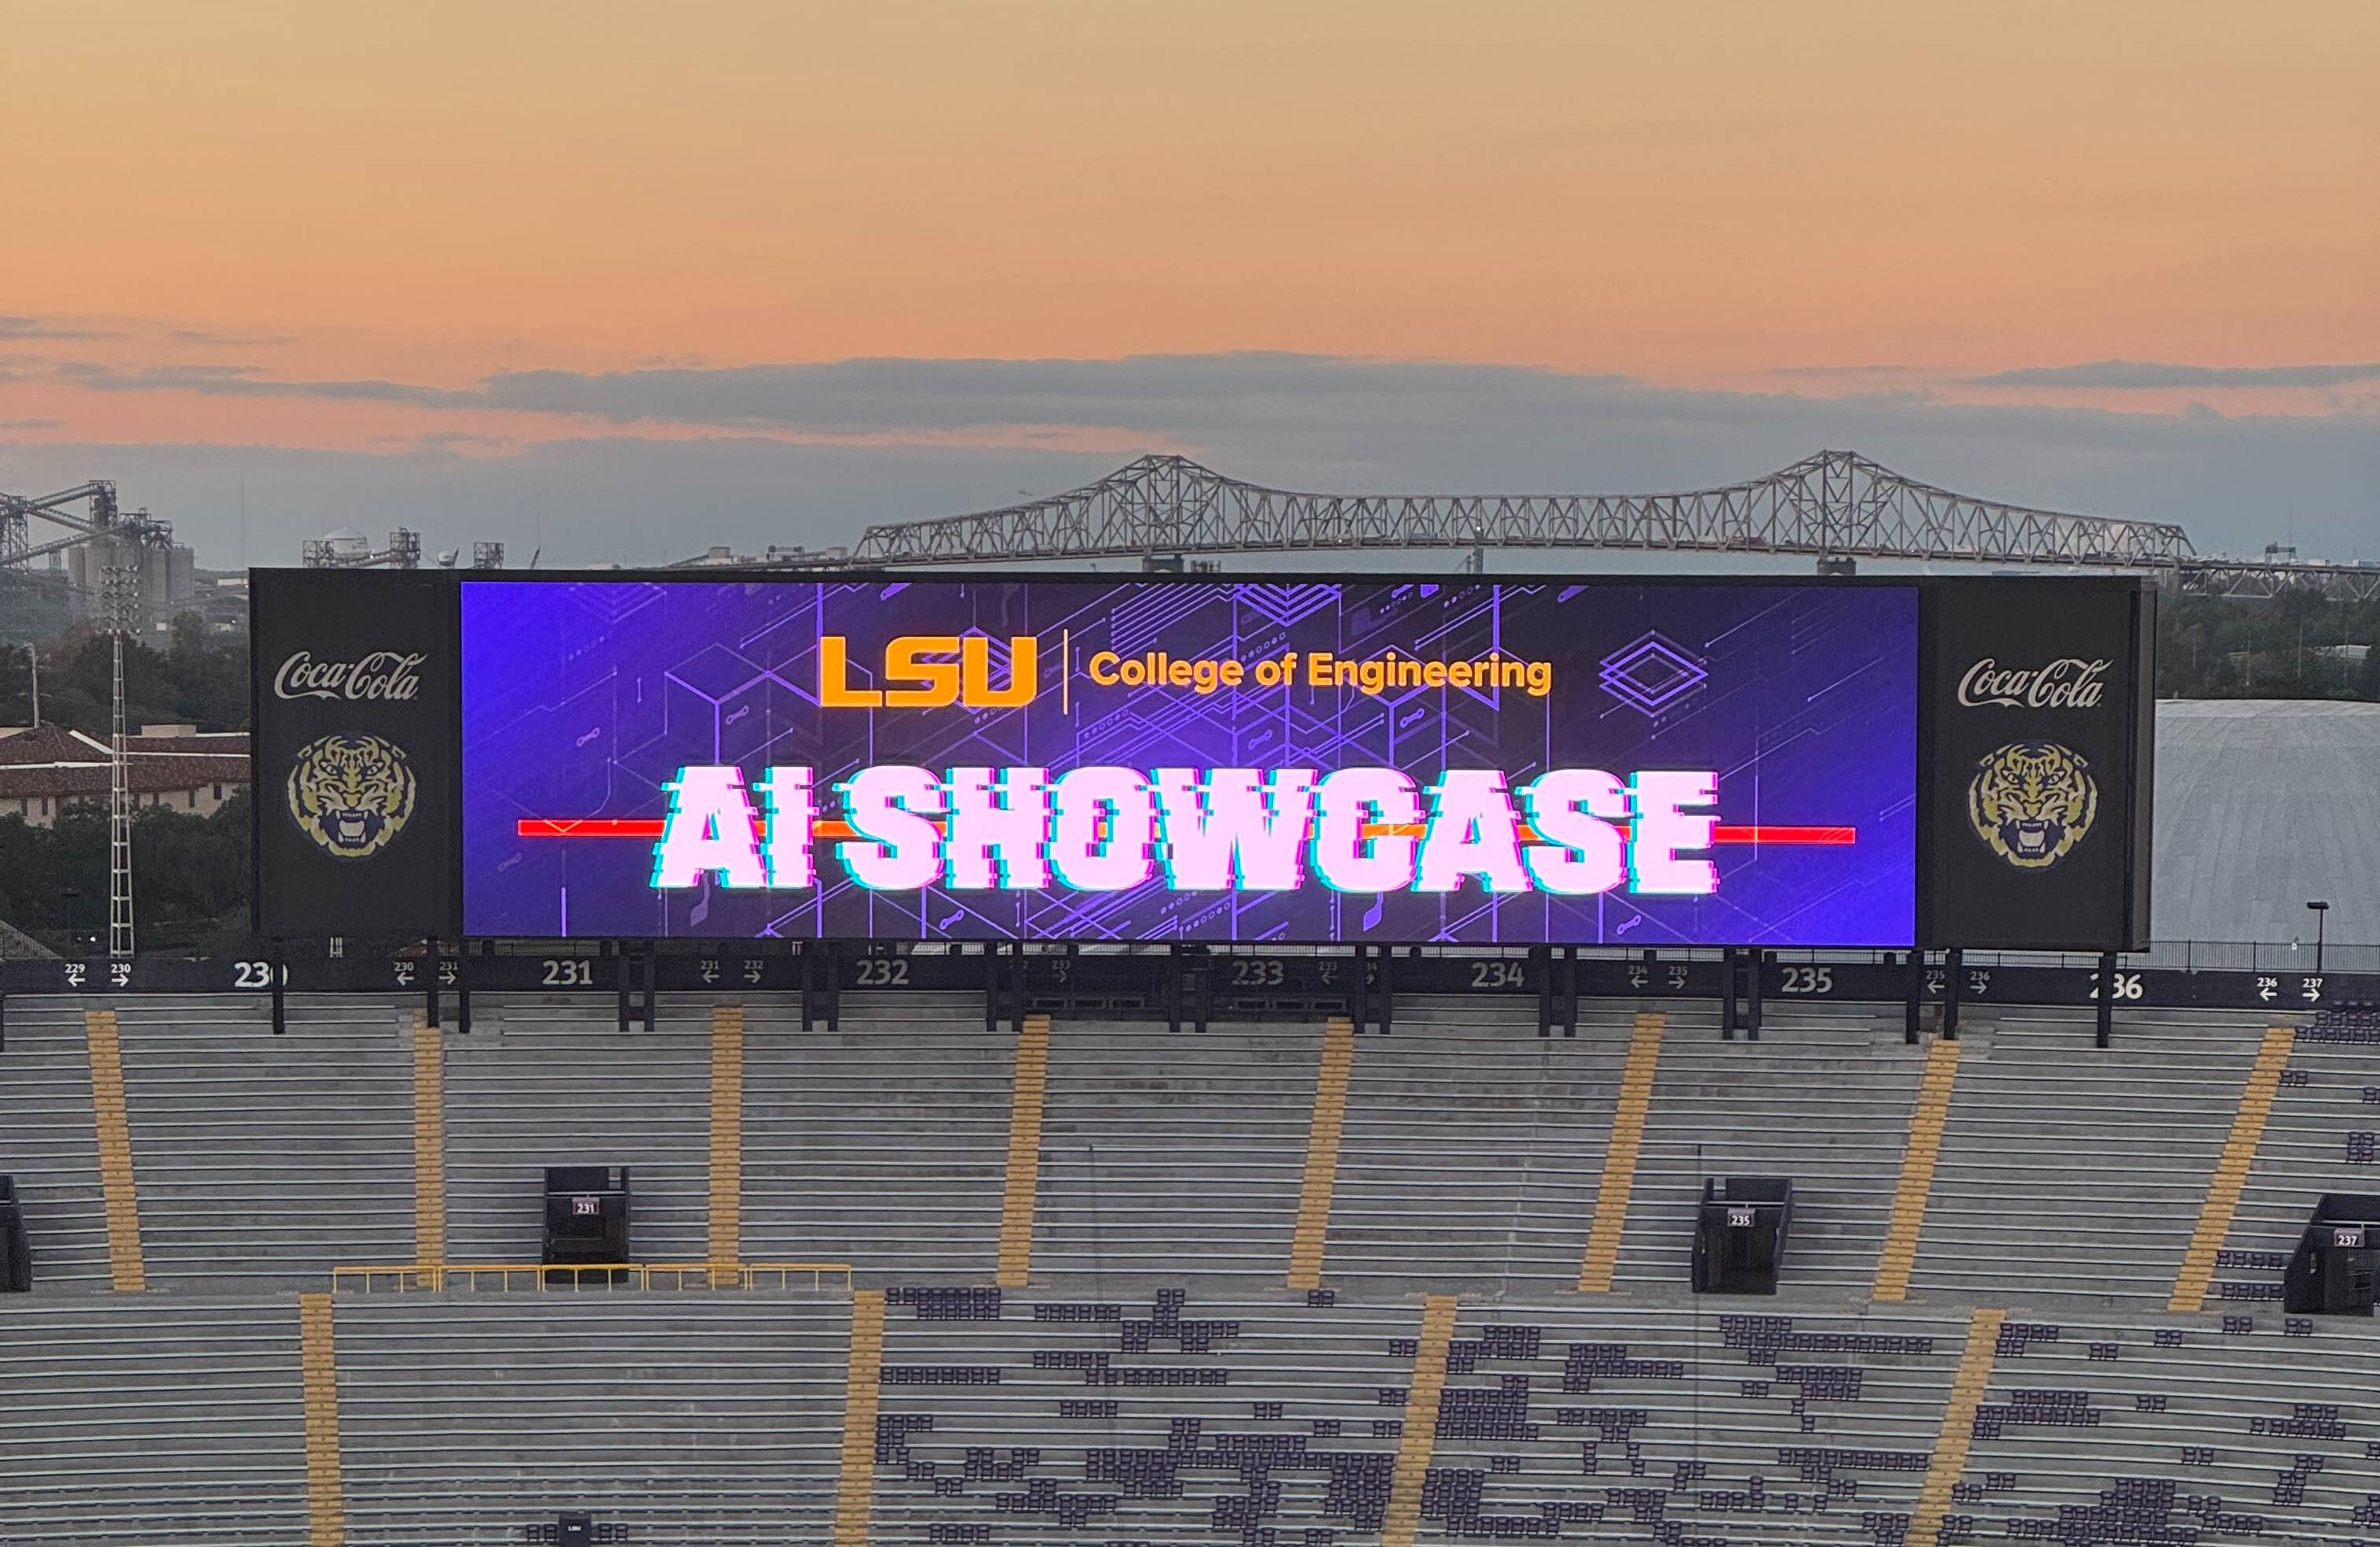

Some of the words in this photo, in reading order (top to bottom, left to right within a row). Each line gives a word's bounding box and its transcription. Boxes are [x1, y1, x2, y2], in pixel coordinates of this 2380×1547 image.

[275, 650, 428, 700] Coca-Cola
[819, 636, 1037, 707] LSU
[1089, 651, 1244, 694] College
[1255, 652, 1298, 686] of
[1308, 651, 1552, 696] Engineering
[1957, 658, 2114, 708] Coca-Cola
[649, 765, 819, 889] AI
[832, 764, 1721, 894] SHOWCASE
[65, 964, 86, 973] 229
[111, 964, 131, 973] 230
[394, 962, 415, 972] 230
[438, 961, 459, 971] 231
[700, 960, 719, 970] 231
[744, 960, 764, 969] 232
[541, 960, 593, 985] 231
[856, 959, 910, 985] 232
[1232, 960, 1285, 985] 233
[1471, 961, 1524, 987] 234
[1628, 965, 1648, 975] 234
[1669, 966, 1688, 975] 235
[1926, 970, 1946, 980] 235
[1781, 967, 1833, 993] 235
[1970, 971, 1990, 981] 236
[2256, 977, 2278, 987] 236
[2302, 978, 2323, 987] 237
[577, 1203, 595, 1213] 231
[1731, 1215, 1750, 1226] 235
[2338, 1234, 2357, 1246] 237
